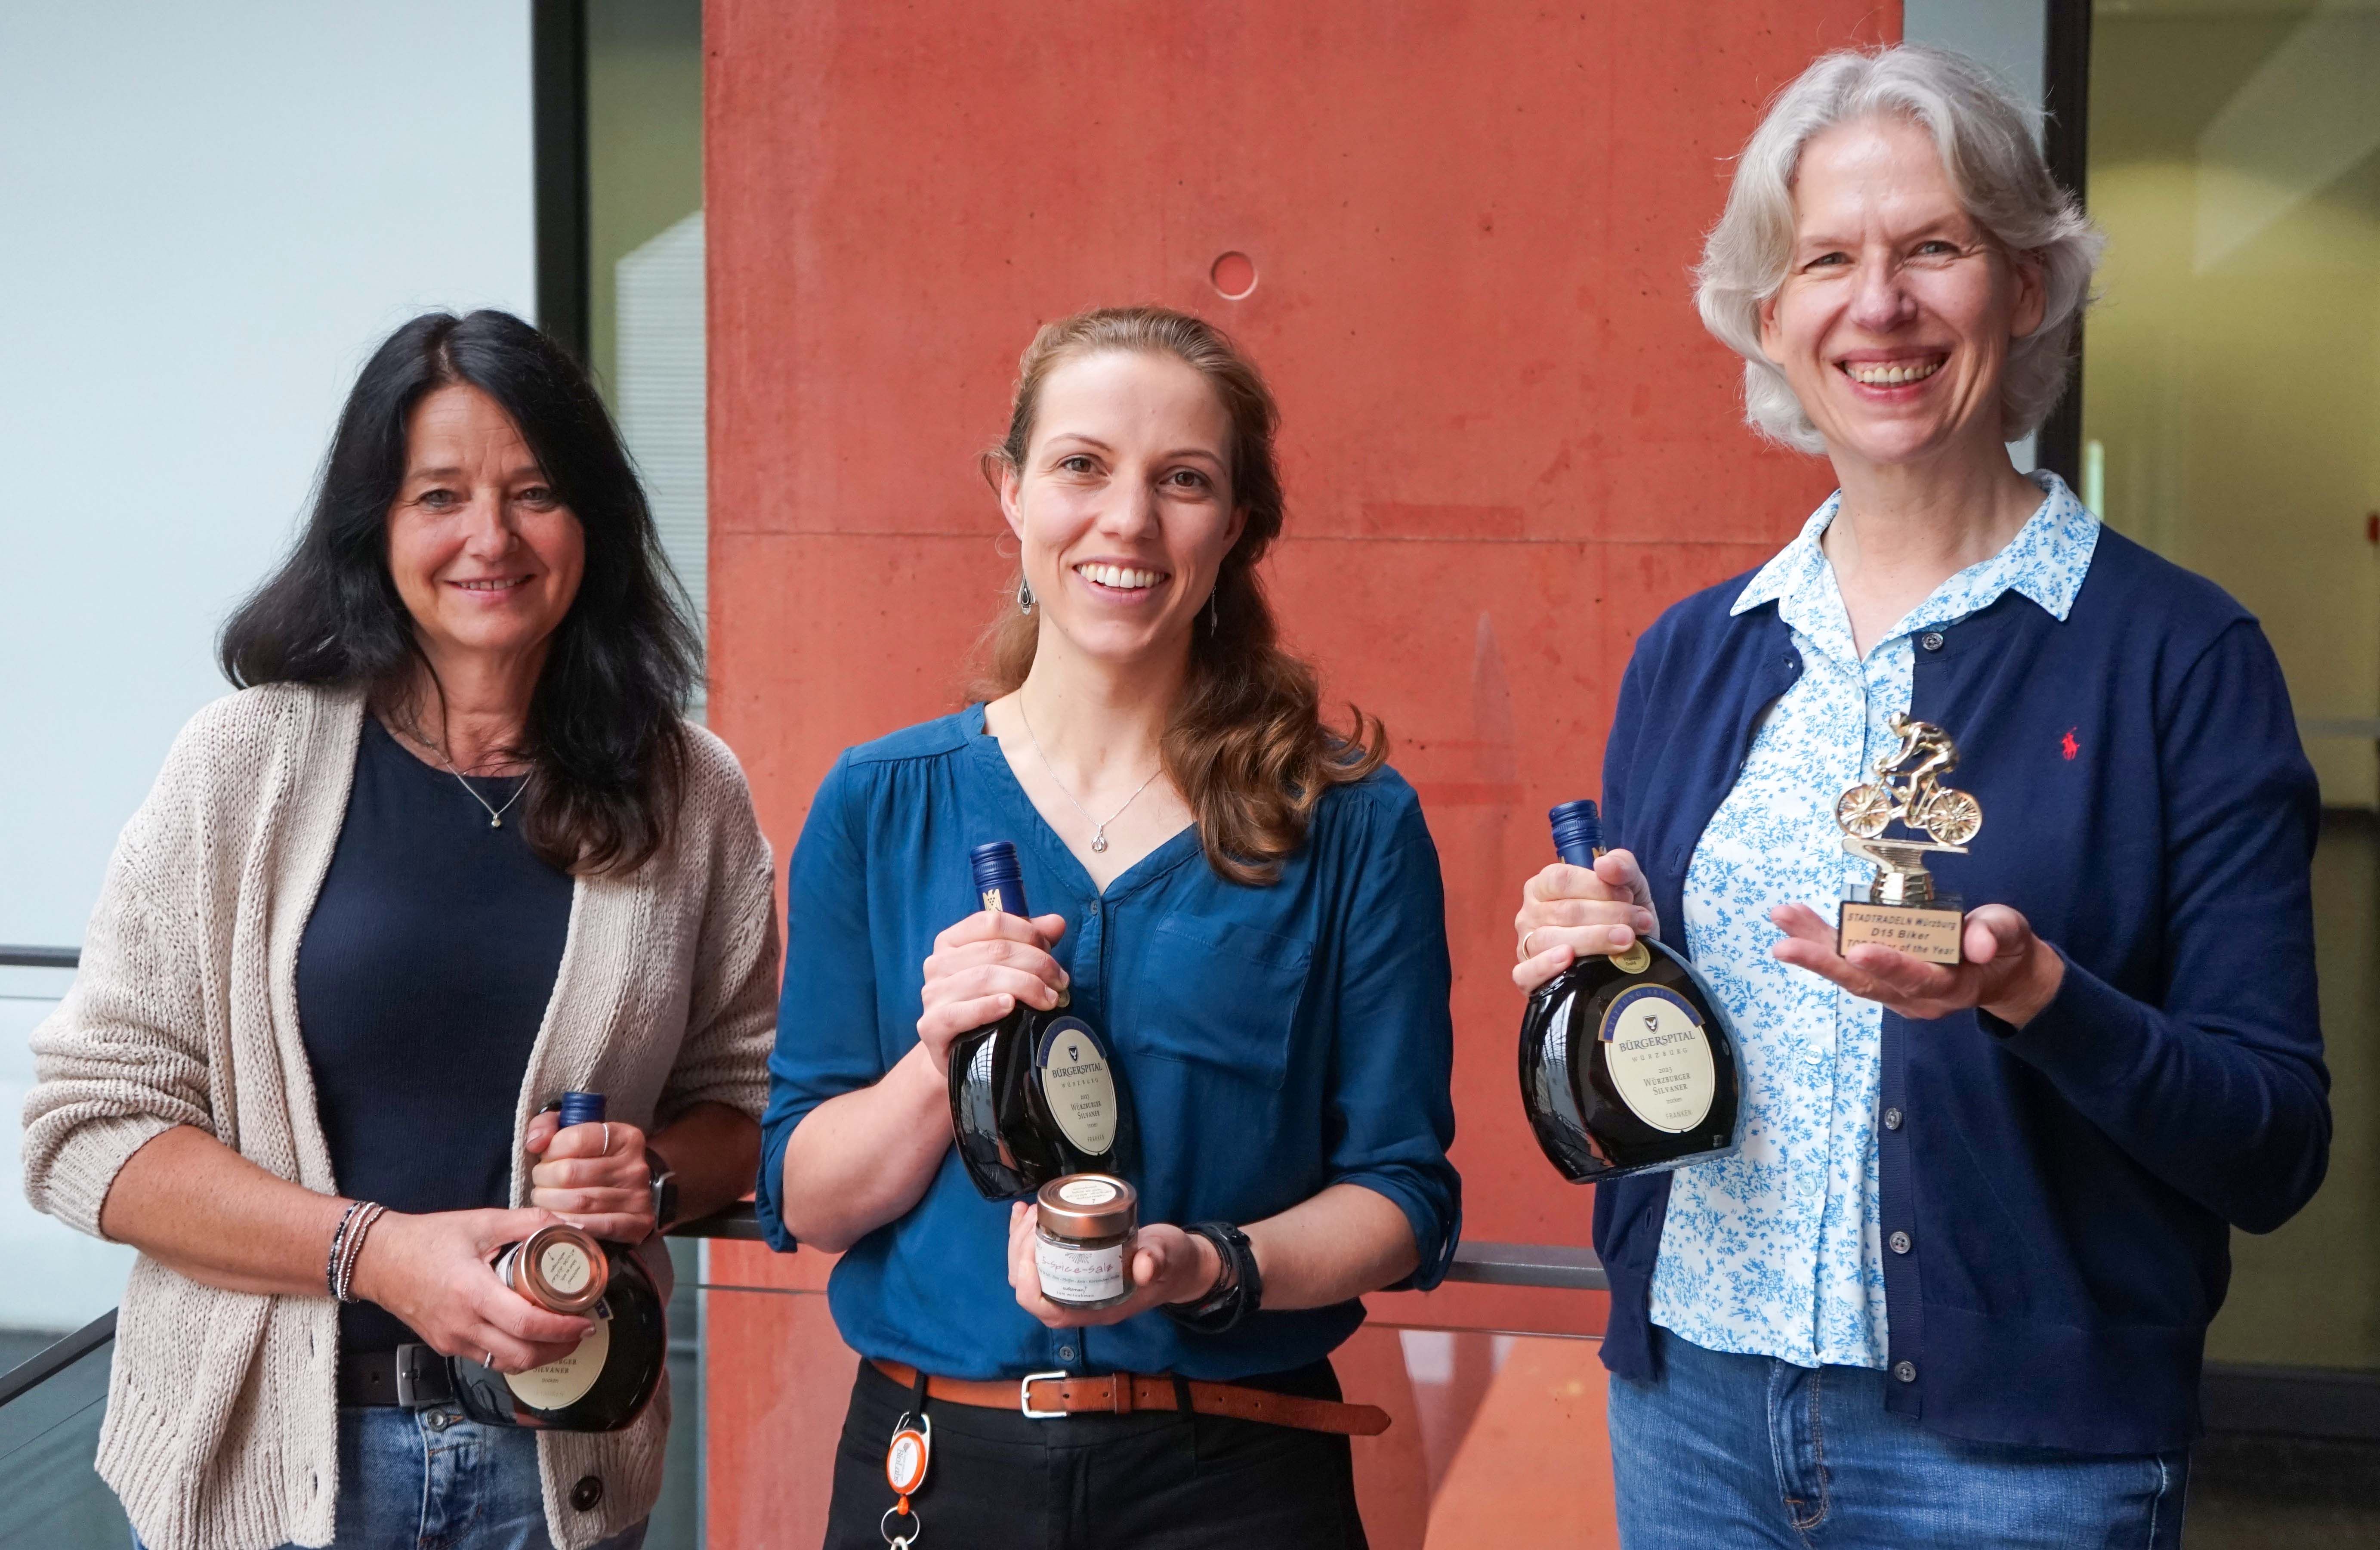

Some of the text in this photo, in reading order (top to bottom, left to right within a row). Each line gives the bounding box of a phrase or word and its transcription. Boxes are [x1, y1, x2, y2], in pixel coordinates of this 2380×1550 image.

[1847, 913, 1957, 930] STADTRADELN Würzburg
[1871, 928, 1929, 940] D15 Biker
[1618, 1031, 1695, 1052] BÜRGERSPITAL
[1632, 1048, 1688, 1062] WÜRZBURG
[1052, 1062, 1102, 1078] BÜRGERSPITAL
[1666, 1109, 1692, 1119] FRANKEN
